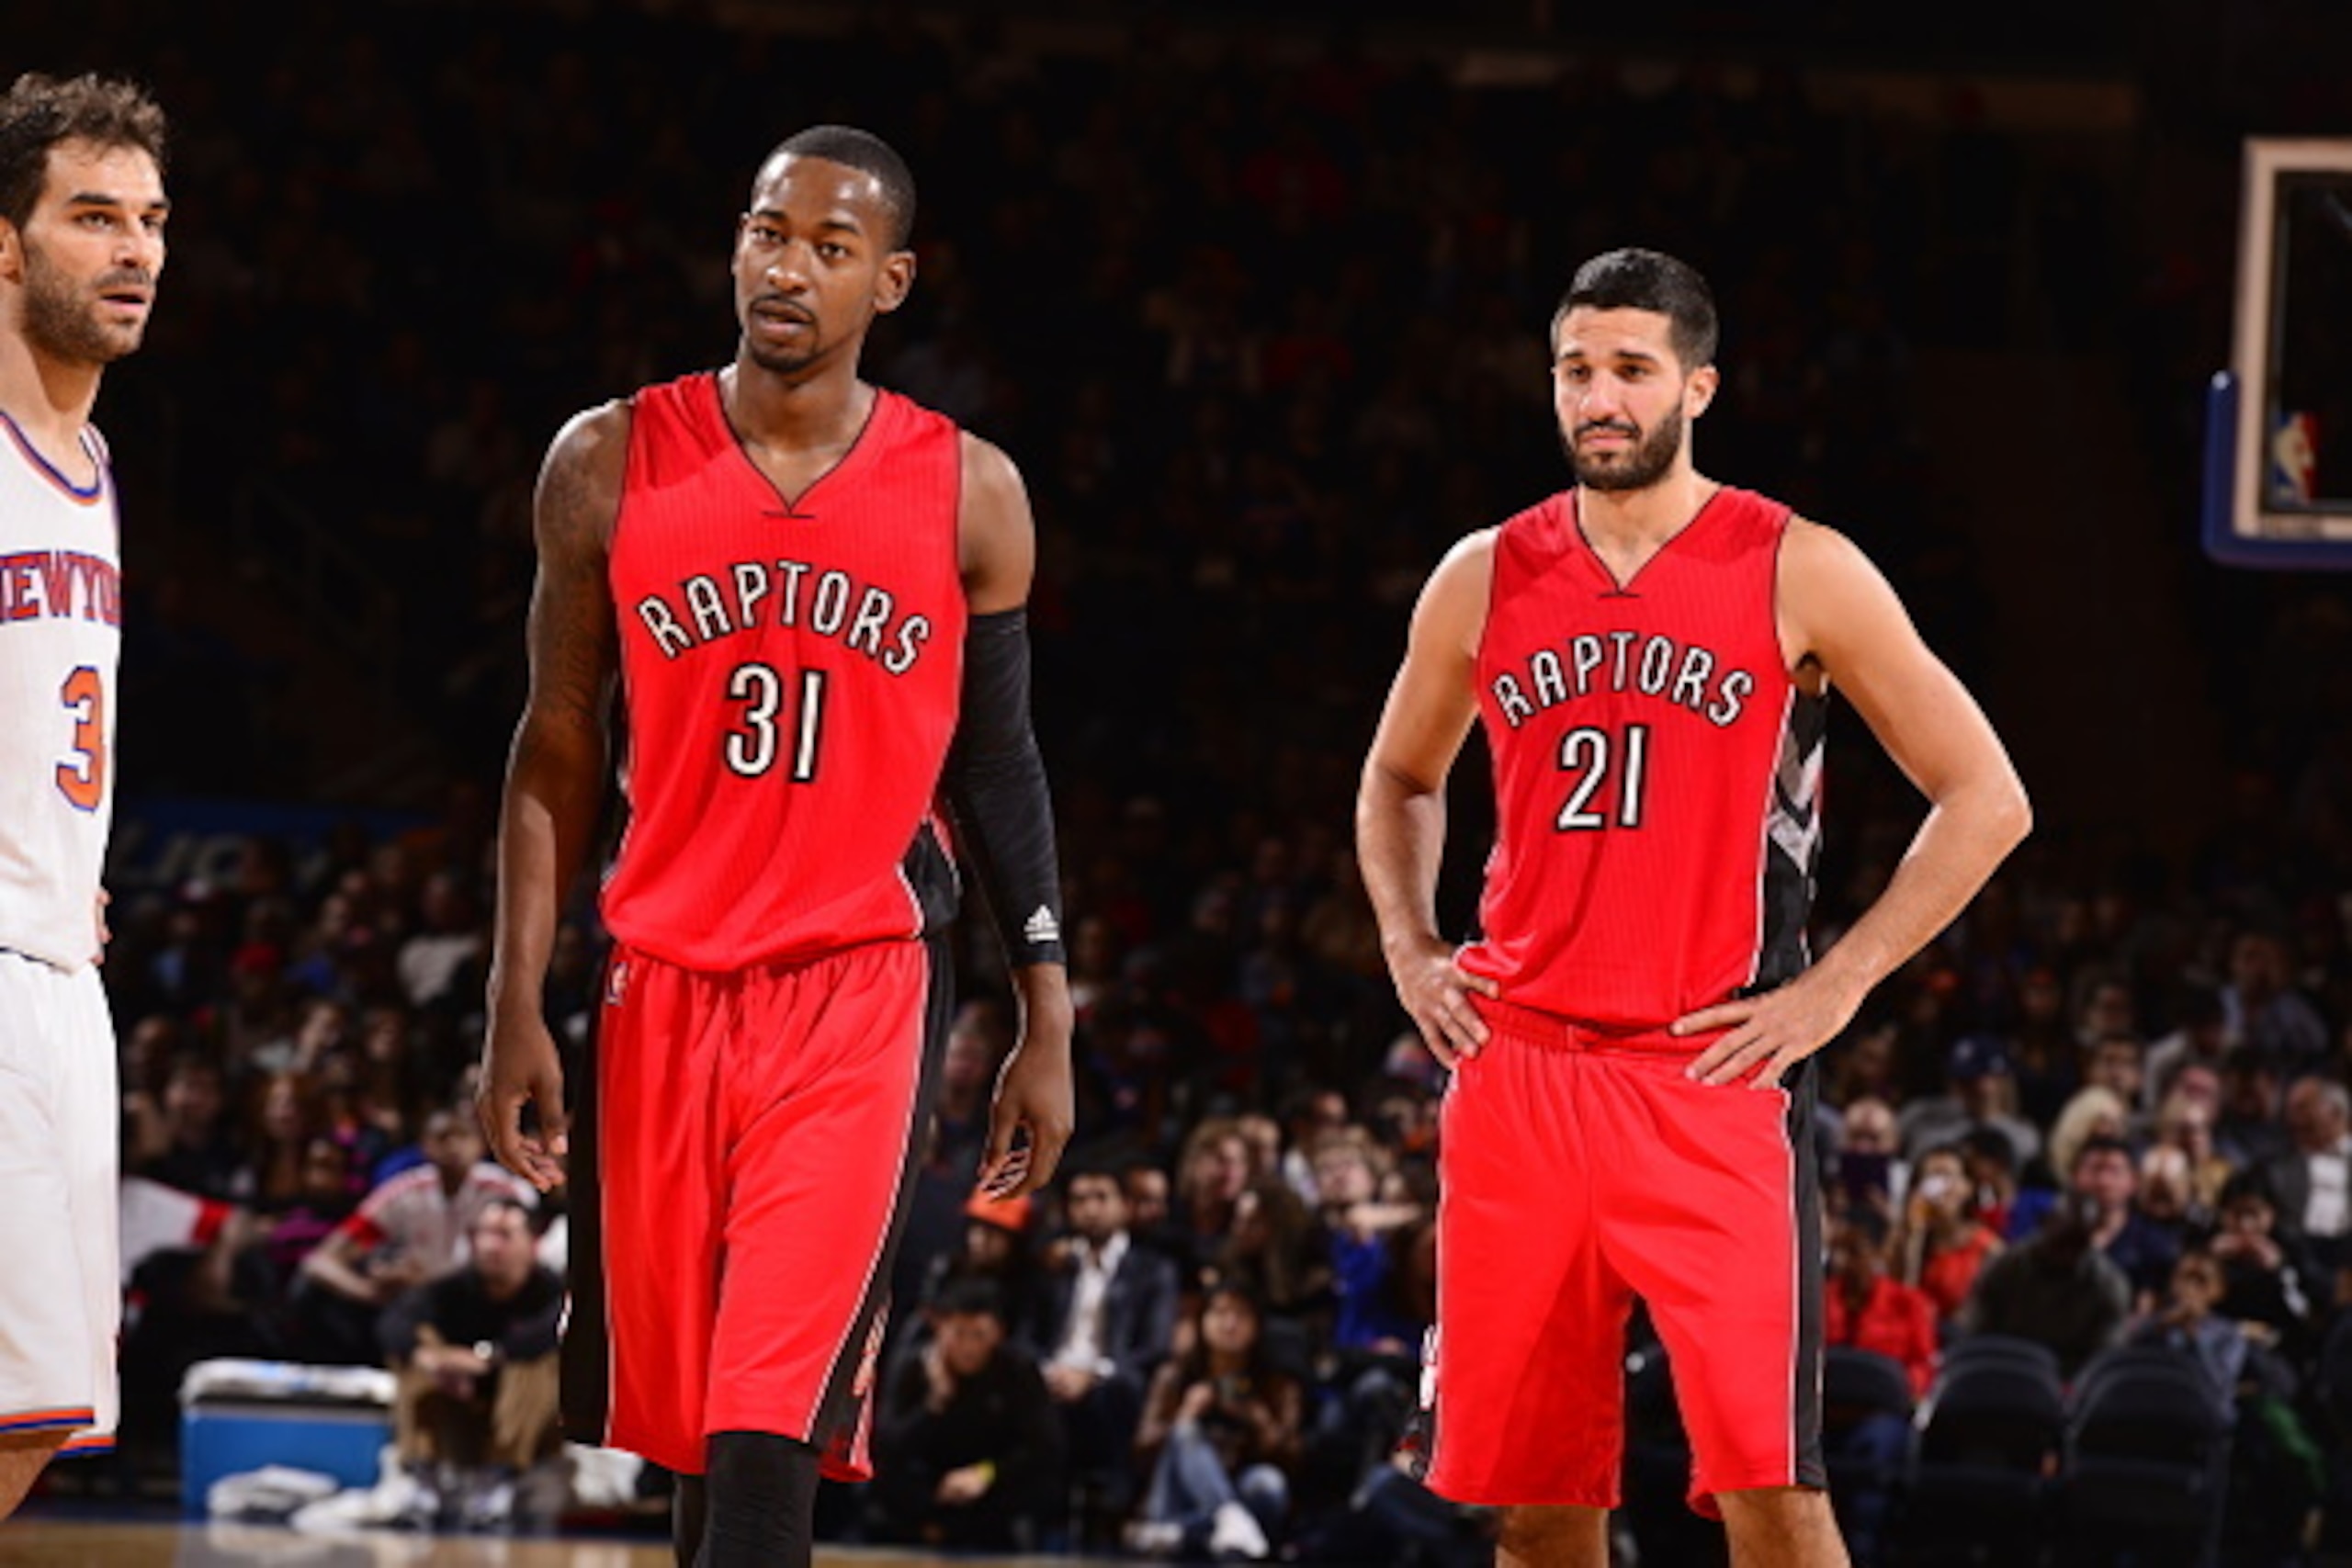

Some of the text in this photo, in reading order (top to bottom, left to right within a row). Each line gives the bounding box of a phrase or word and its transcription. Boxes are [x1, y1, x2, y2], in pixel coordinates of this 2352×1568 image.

[636, 560, 931, 675] RAPTORS
[725, 662, 828, 782] 31
[1492, 631, 1755, 728] RAPTORS
[55, 666, 104, 814] 3
[1555, 724, 1650, 831] 21
